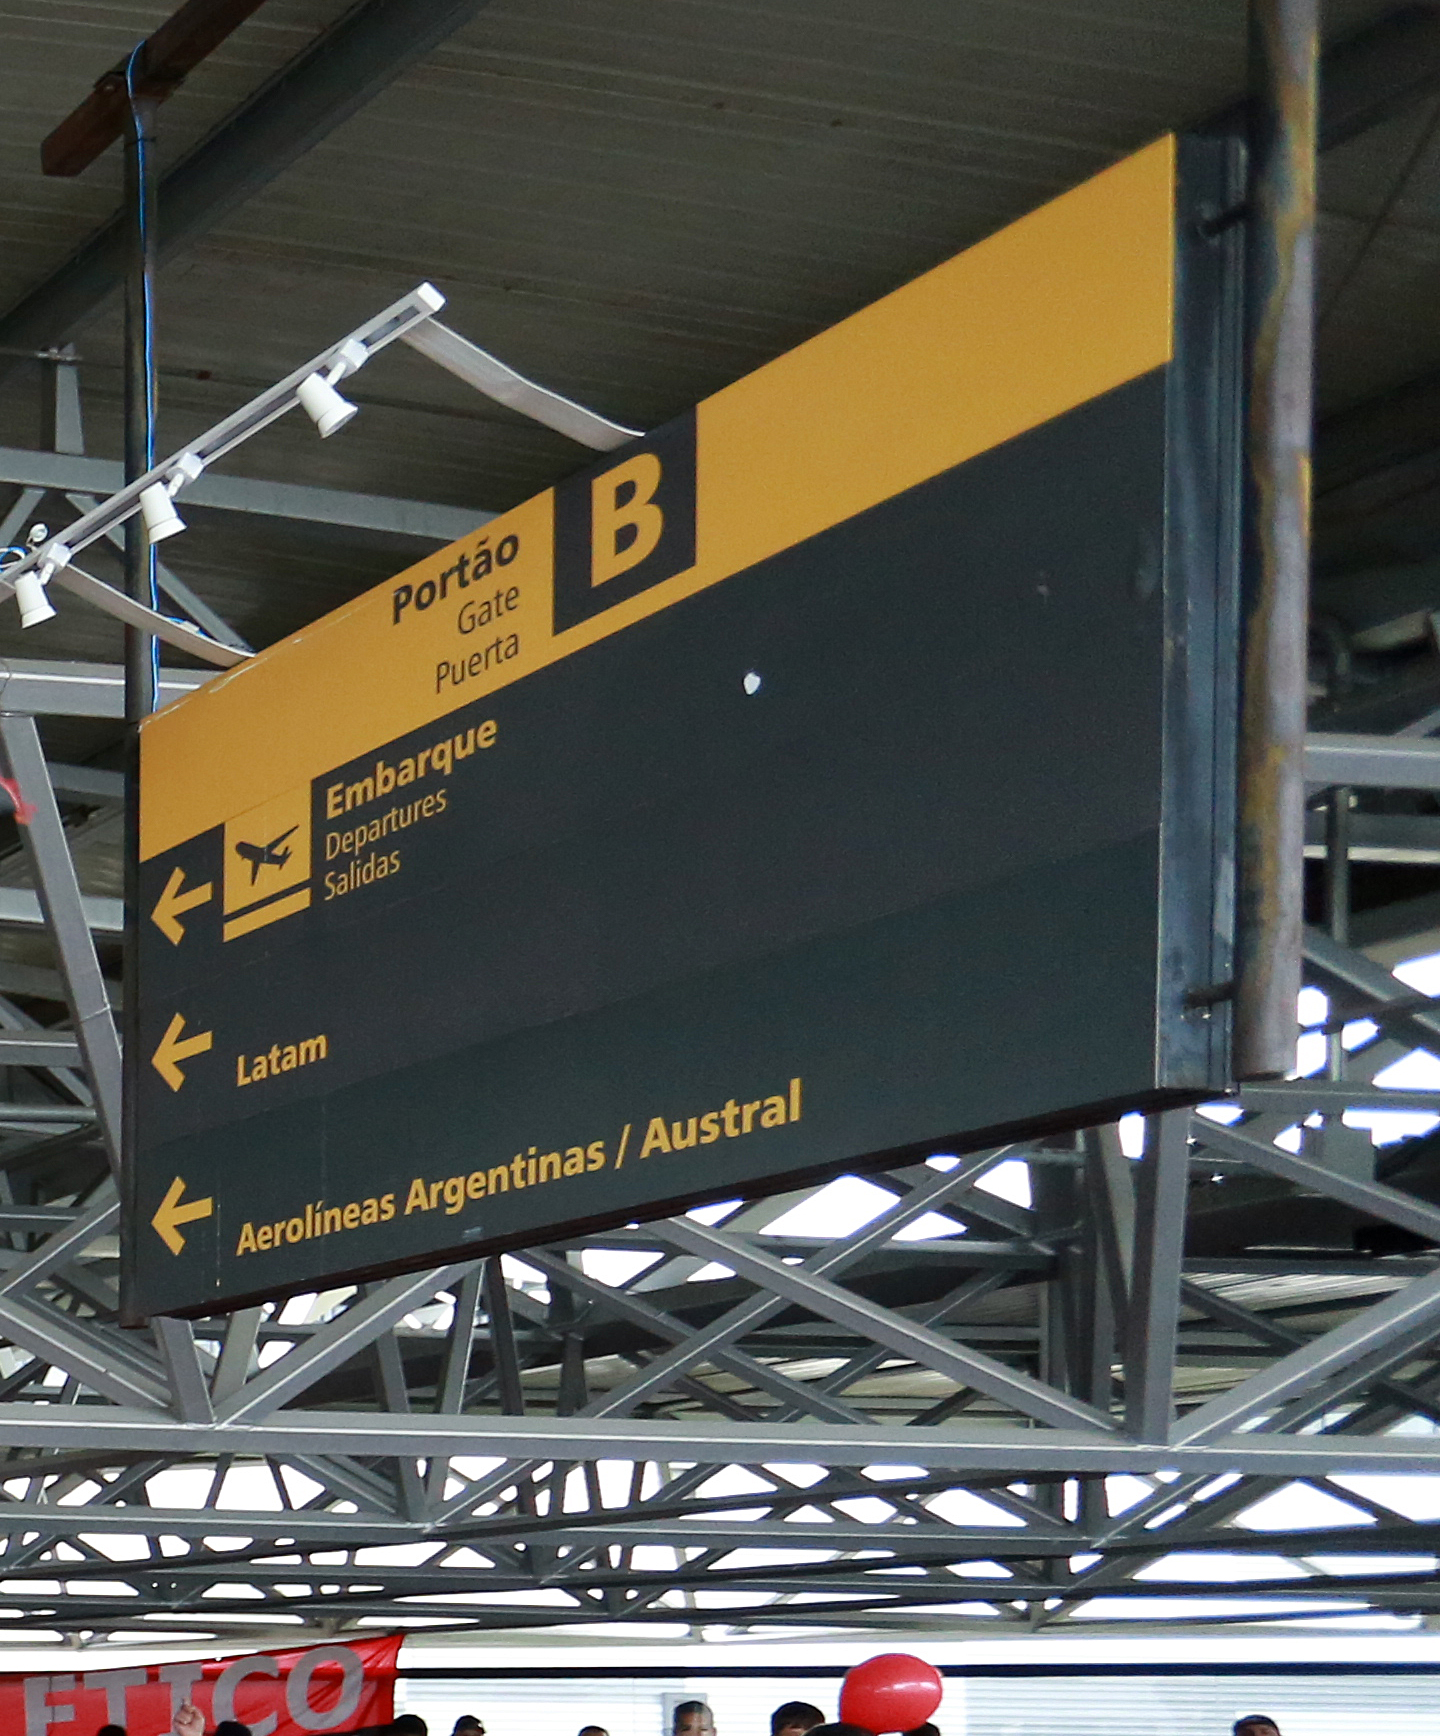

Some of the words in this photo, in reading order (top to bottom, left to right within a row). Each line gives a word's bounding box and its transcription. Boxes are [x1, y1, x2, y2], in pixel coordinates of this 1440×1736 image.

[591, 450, 665, 589] B
[391, 527, 520, 626] Portão
[456, 583, 520, 636] Gate
[434, 630, 520, 695] Puerta
[325, 716, 498, 819] Embarque
[325, 787, 448, 860] Departures
[324, 847, 401, 901] Salidas
[235, 1030, 328, 1087] Latam
[236, 1190, 396, 1257] Aerolíneas
[405, 1134, 605, 1217] Argentinas
[640, 1078, 802, 1160] Austral
